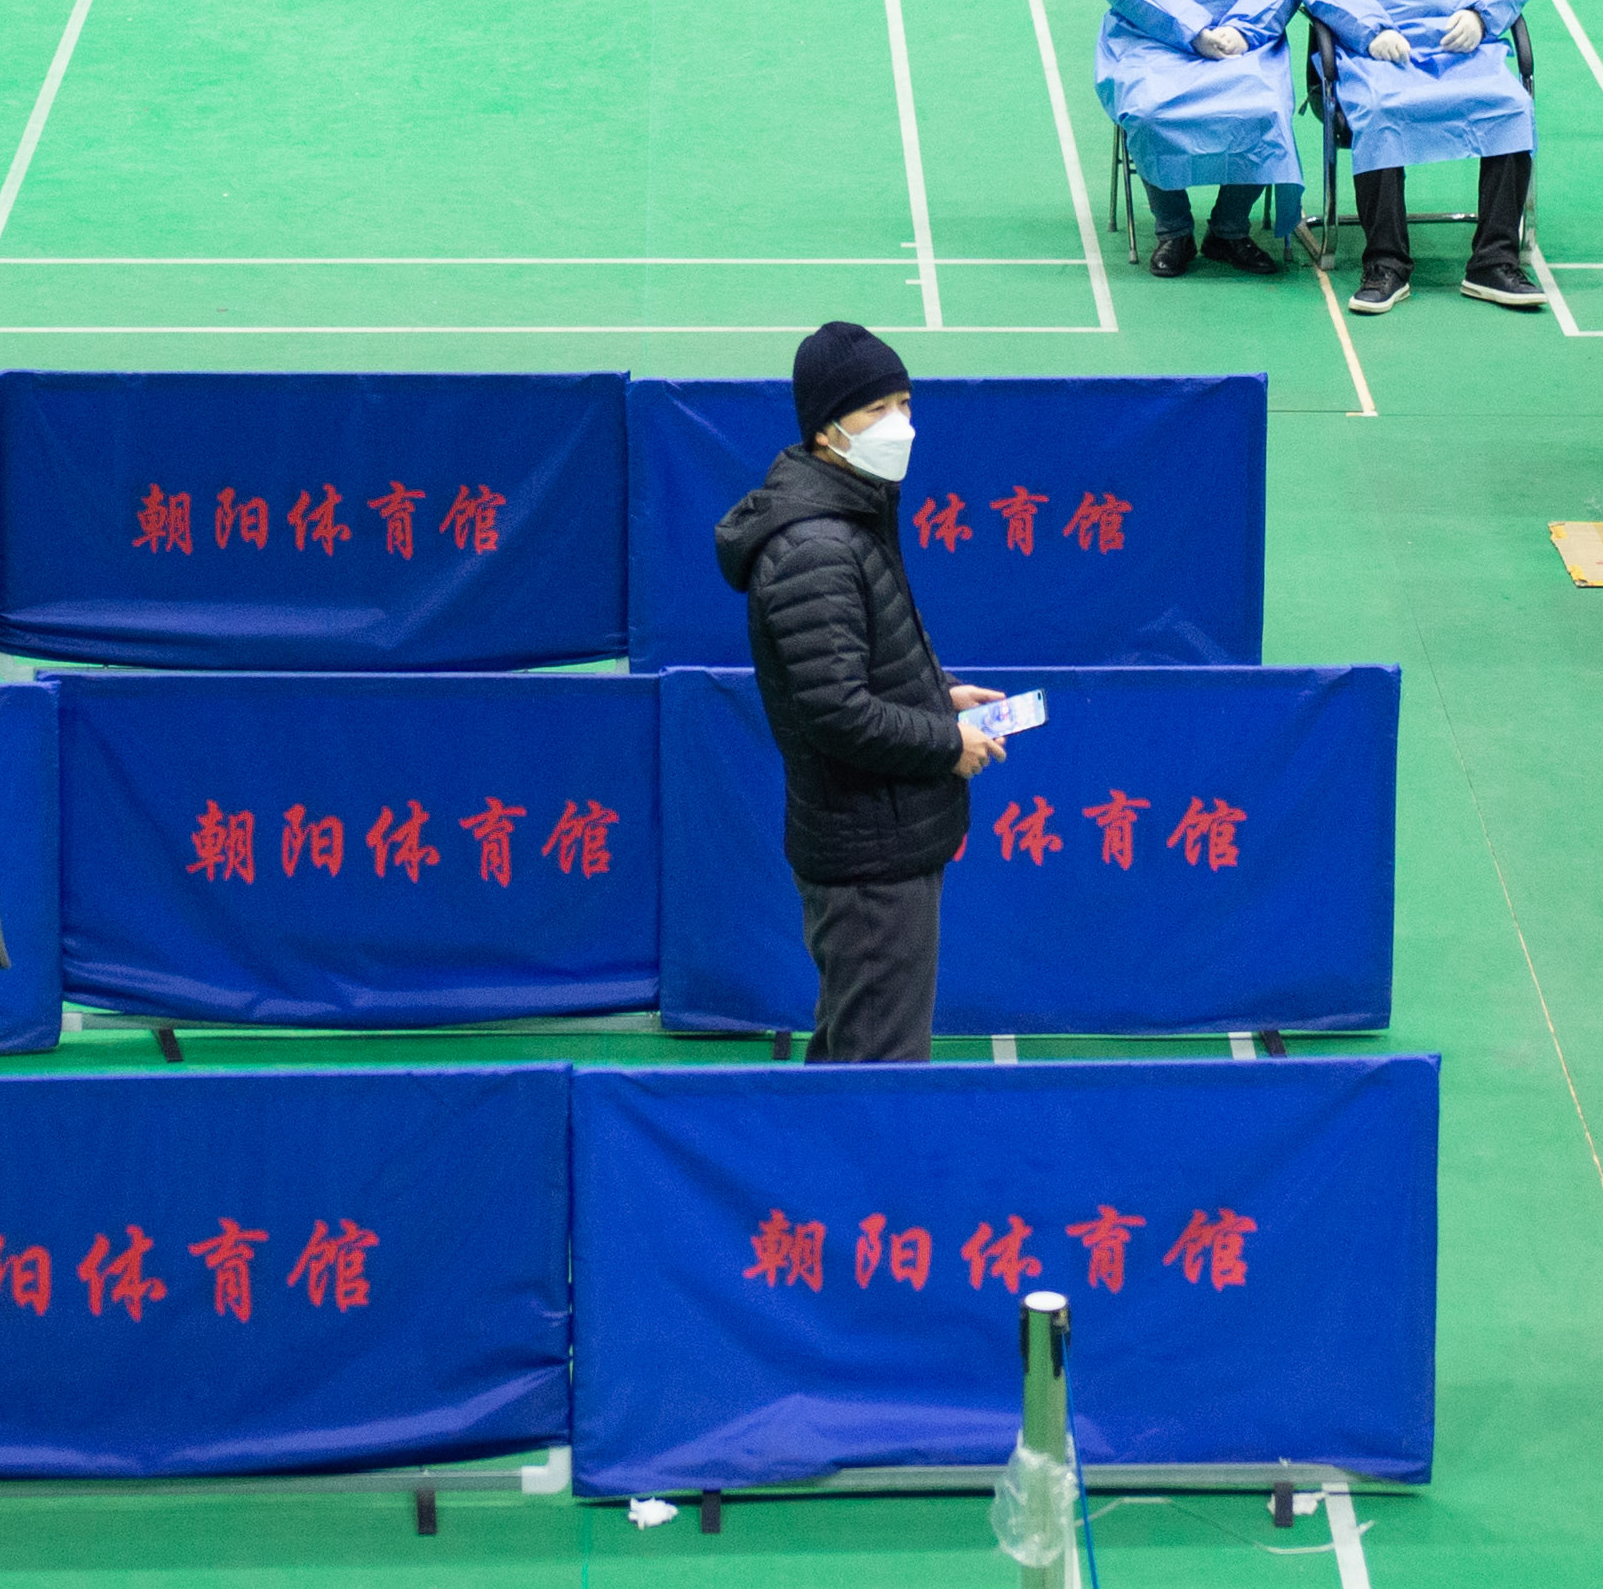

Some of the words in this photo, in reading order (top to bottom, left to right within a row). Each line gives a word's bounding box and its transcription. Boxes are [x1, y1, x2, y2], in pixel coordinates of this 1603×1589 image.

[132, 480, 507, 559] 朝阳体育馆
[912, 485, 1133, 556] 体育馆
[186, 796, 619, 888] 朝阳体育馆
[951, 789, 1248, 872] 体育馆
[743, 1205, 1257, 1293] 朝阳体育馆
